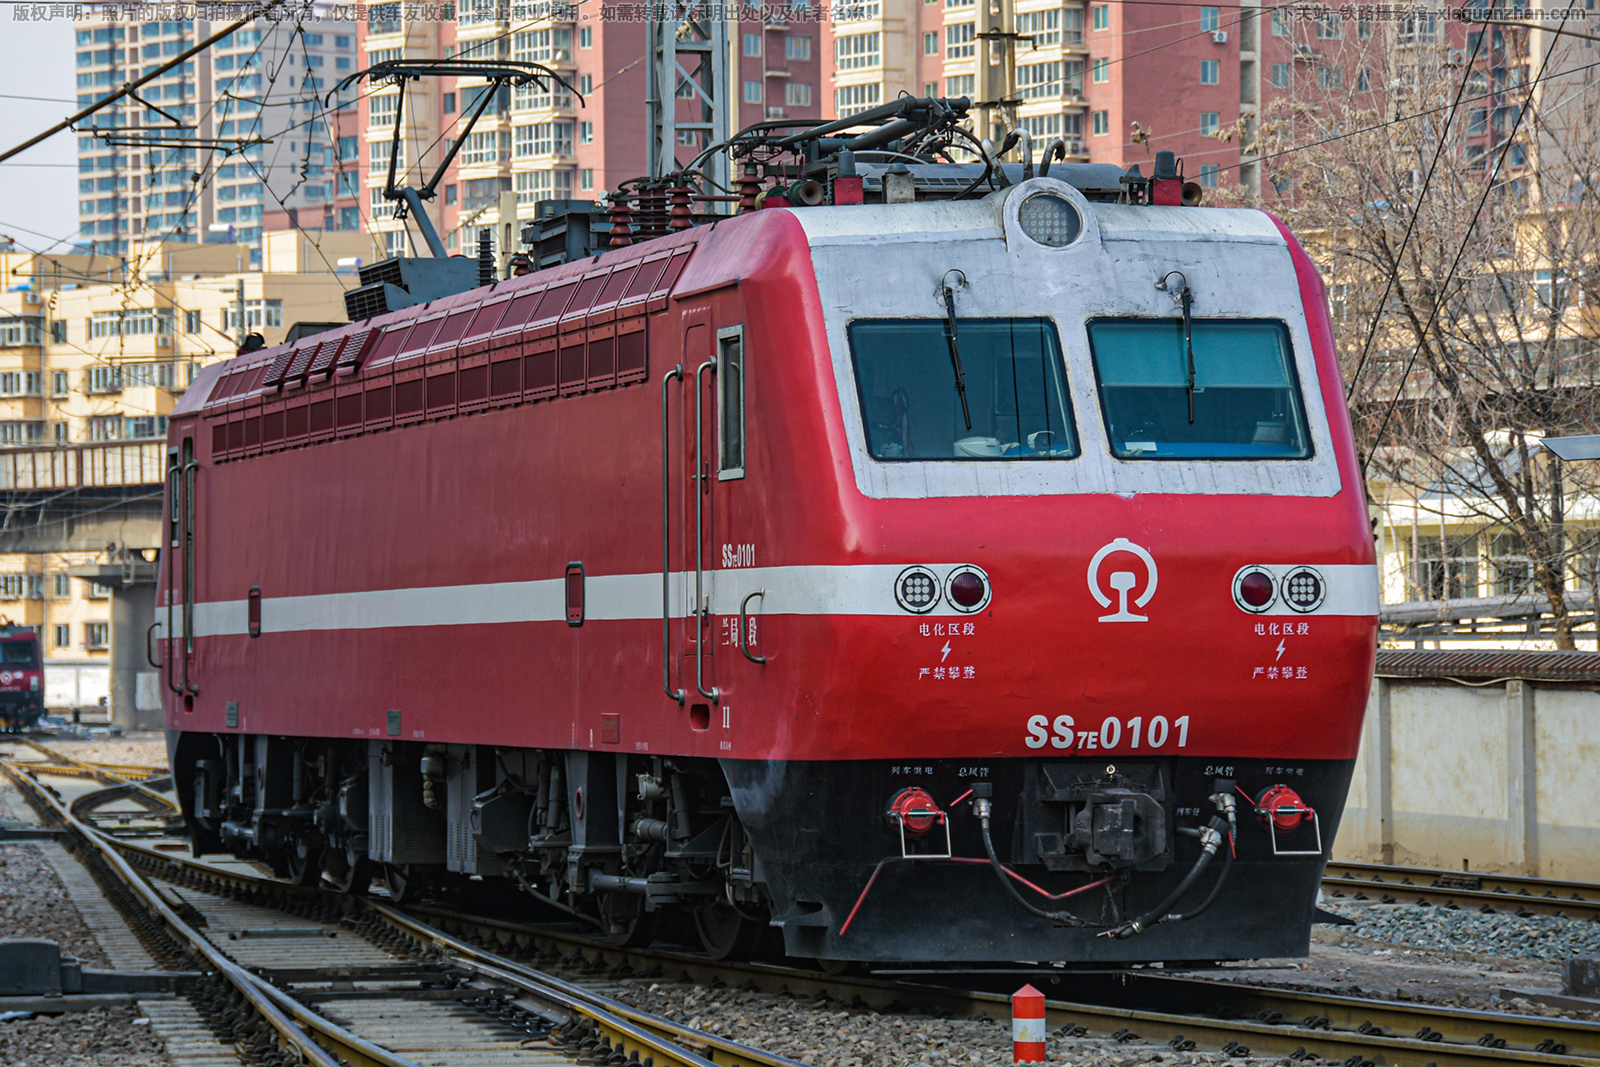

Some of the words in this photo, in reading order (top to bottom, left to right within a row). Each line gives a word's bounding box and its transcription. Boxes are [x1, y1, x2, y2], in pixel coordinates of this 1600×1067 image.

[919, 622, 975, 637] 电化区段
[1254, 621, 1309, 636] 电化区段
[918, 665, 975, 680] 严禁攀登
[1252, 665, 1308, 680] 严禁攀登
